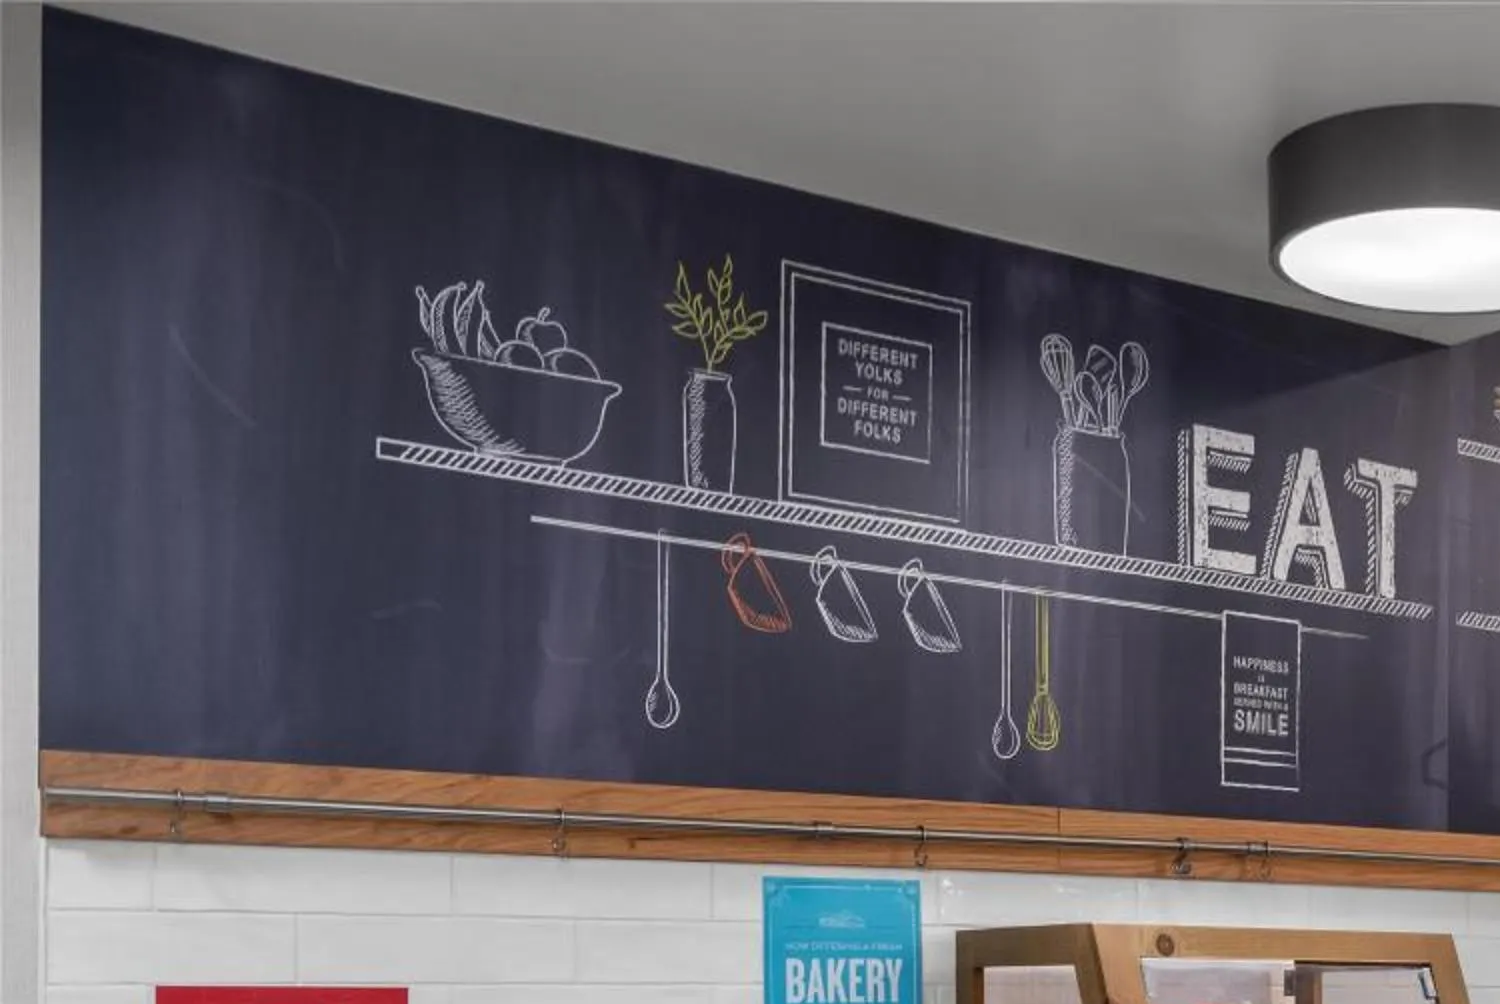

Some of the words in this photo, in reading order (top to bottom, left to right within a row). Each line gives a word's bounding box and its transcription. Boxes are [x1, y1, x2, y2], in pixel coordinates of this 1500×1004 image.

[838, 338, 918, 369] DIFFERENT
[855, 360, 903, 385] YOLKS
[867, 386, 889, 401] FOR
[837, 396, 918, 427] DIFFERENT
[853, 419, 902, 444] FOLKS
[1177, 422, 1418, 599] EAT
[1233, 655, 1289, 674] HAPPINESS
[1233, 682, 1289, 700] BREAKFAST
[1233, 708, 1289, 736] SMILE
[785, 957, 903, 1004] BAKERY
